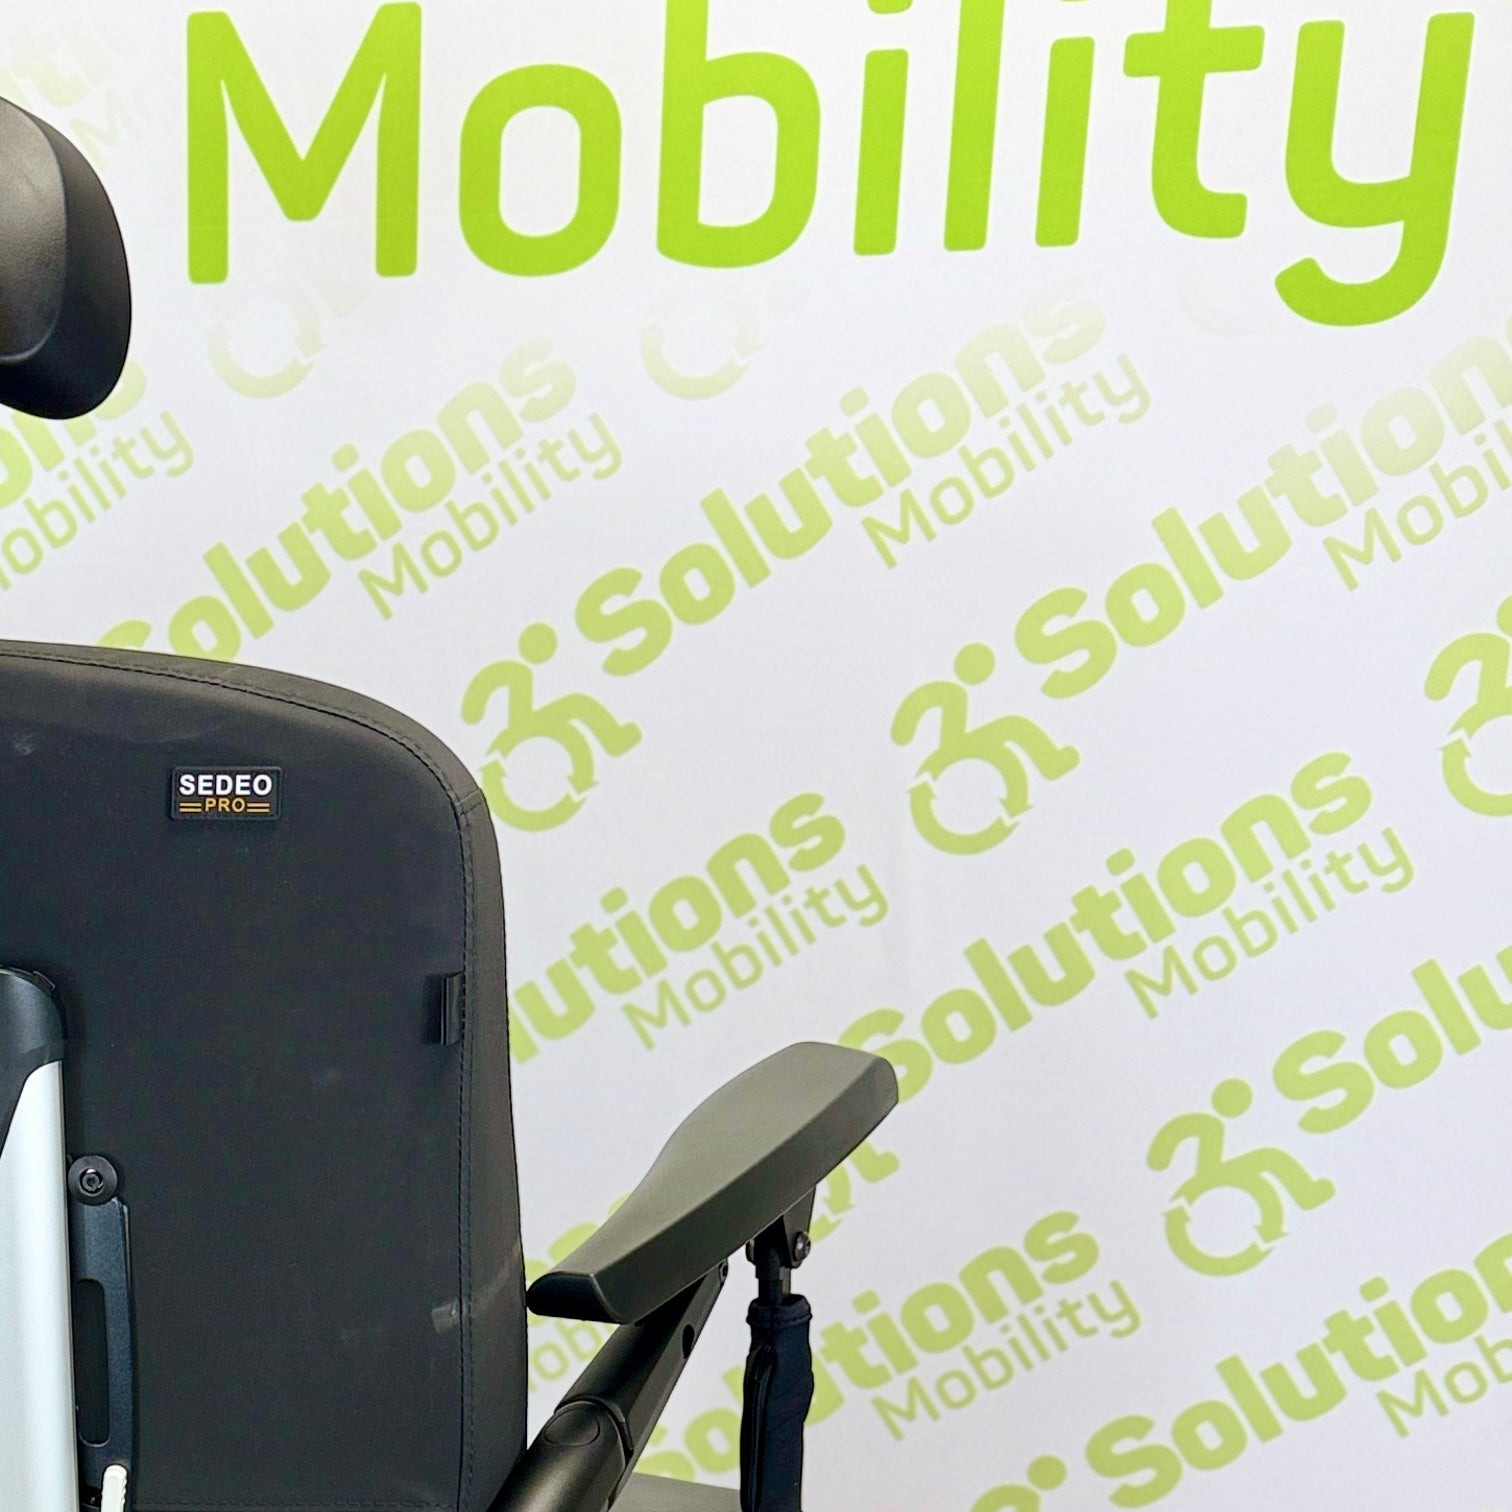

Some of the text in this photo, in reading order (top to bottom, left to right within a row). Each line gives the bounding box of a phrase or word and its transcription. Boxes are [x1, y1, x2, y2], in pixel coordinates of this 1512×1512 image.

[186, 0, 1476, 327] Mobility
[358, 414, 623, 620] Mobility
[574, 277, 1107, 678] Solutions
[862, 353, 1152, 569] Mobility
[1013, 312, 1512, 699] Solution
[178, 773, 273, 796] SEDEO
[204, 797, 246, 813] PRO
[622, 863, 888, 1050] Mobility
[836, 752, 1372, 1103] Solutions
[1124, 827, 1415, 1018] Mobility
[872, 1277, 1142, 1440] Mobility
